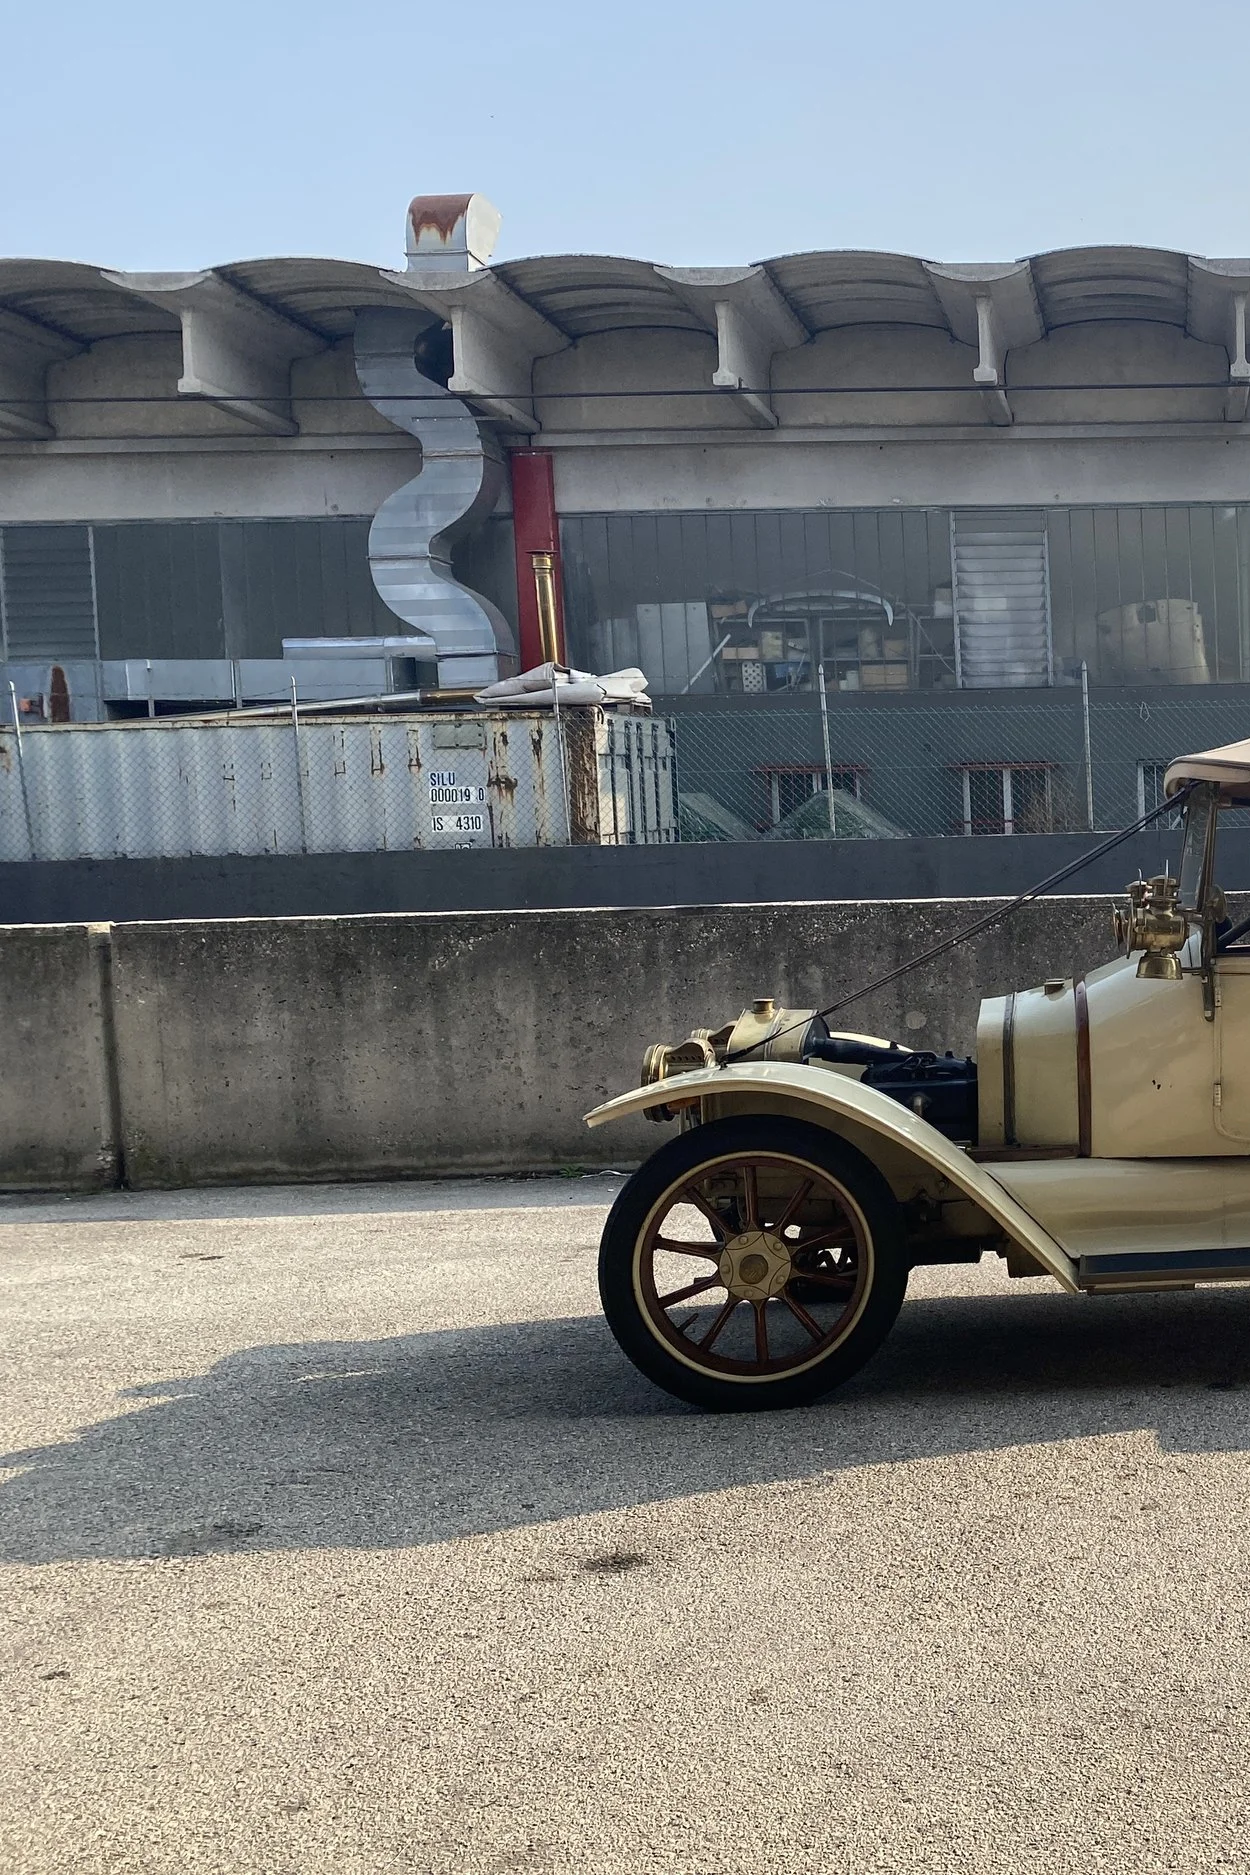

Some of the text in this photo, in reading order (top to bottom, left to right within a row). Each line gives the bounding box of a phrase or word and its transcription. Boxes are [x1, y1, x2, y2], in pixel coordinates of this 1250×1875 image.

[430, 773, 455, 786] SILU
[431, 788, 471, 802] 000019
[433, 816, 481, 831] IS 4310
